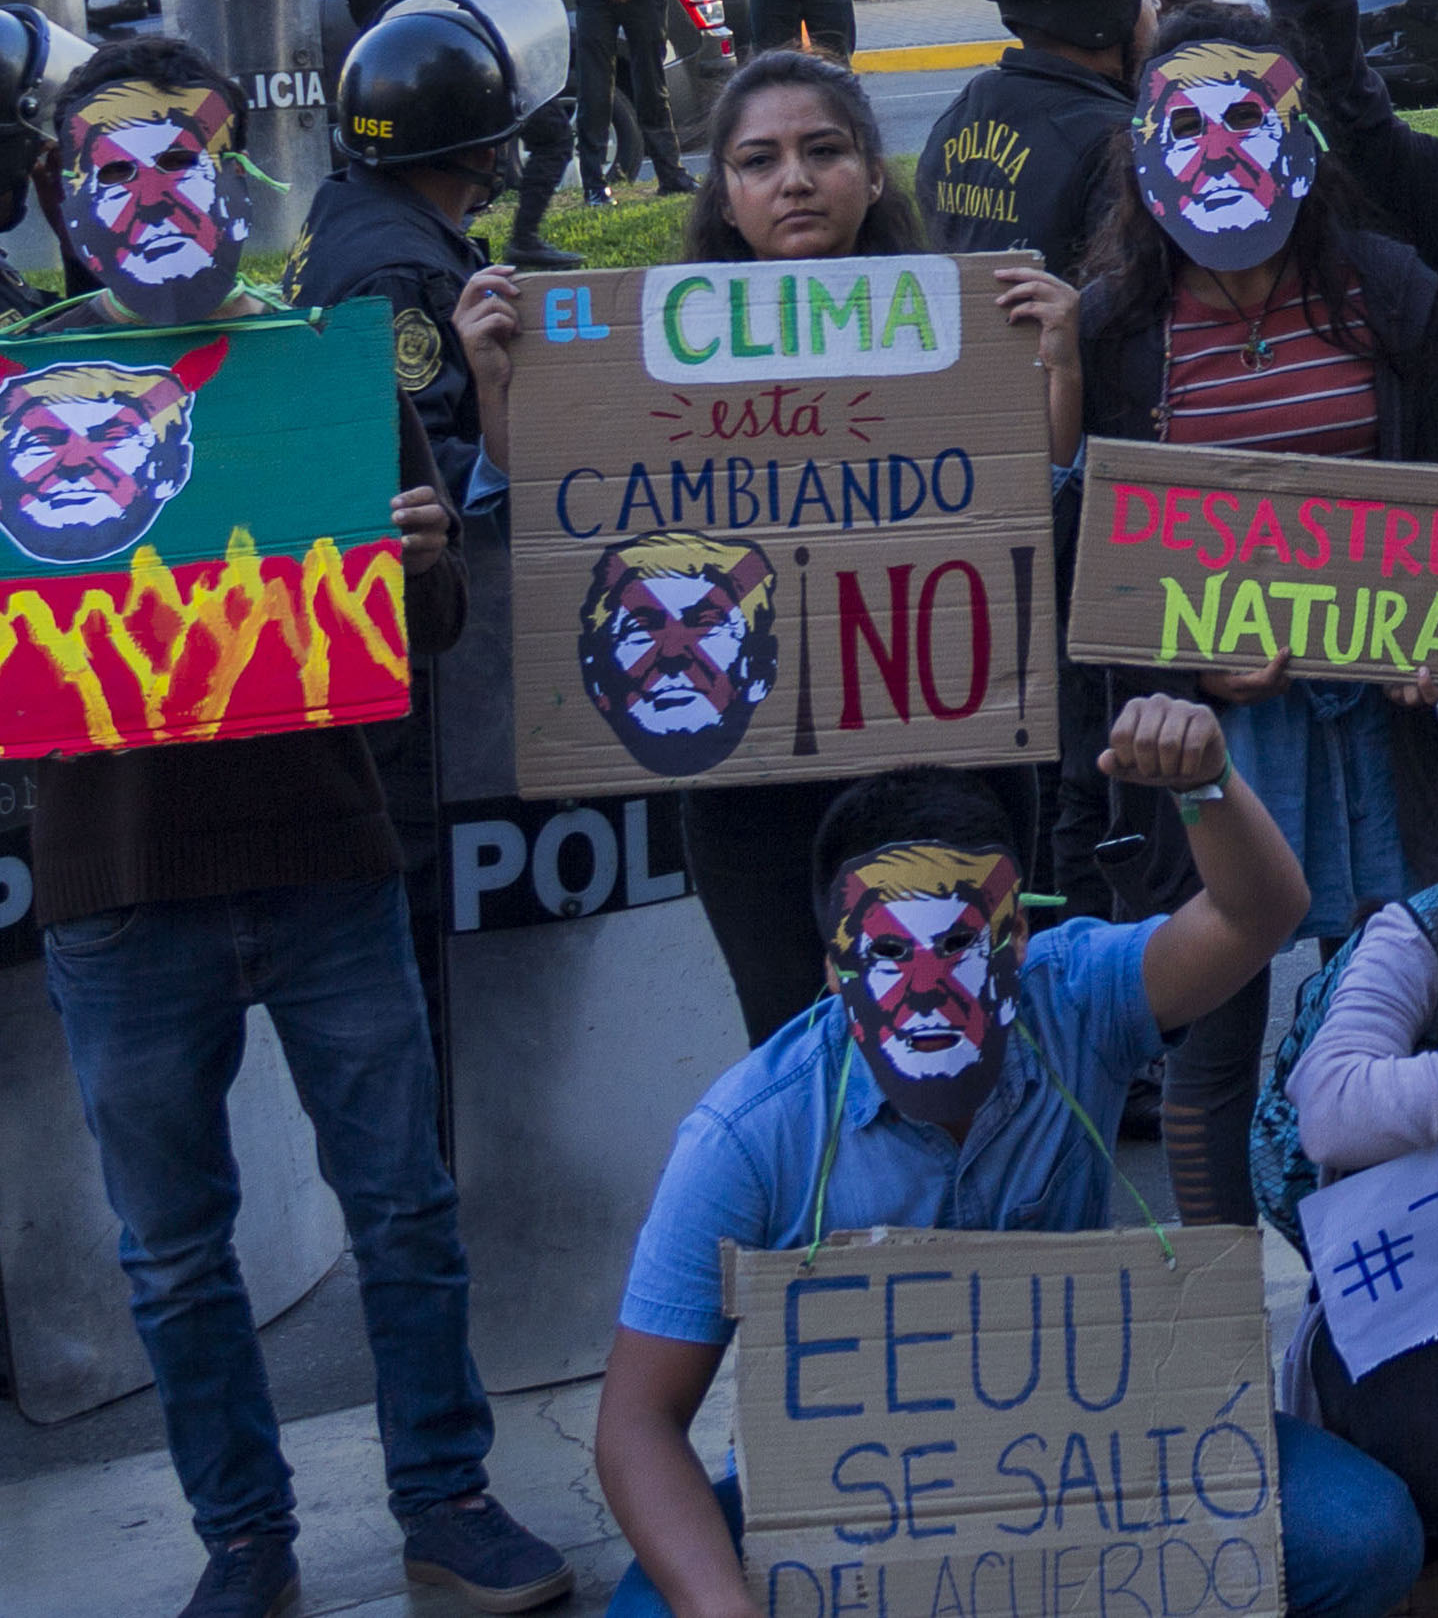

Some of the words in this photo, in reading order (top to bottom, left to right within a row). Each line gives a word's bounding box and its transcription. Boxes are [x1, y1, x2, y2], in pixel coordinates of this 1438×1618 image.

[229, 70, 326, 109] ICIA
[353, 115, 394, 139] USE
[943, 119, 1032, 185] POLICIA
[936, 180, 1019, 223] NACIONAL
[543, 286, 610, 343] EL
[663, 270, 937, 366] CLIMA
[701, 385, 828, 440] está
[555, 447, 975, 539] CAMBIANDO
[451, 799, 687, 931] POL
[785, 1268, 1131, 1420] EEUU
[832, 1440, 956, 1545] SE
[996, 1382, 1269, 1537] SALIÓ
